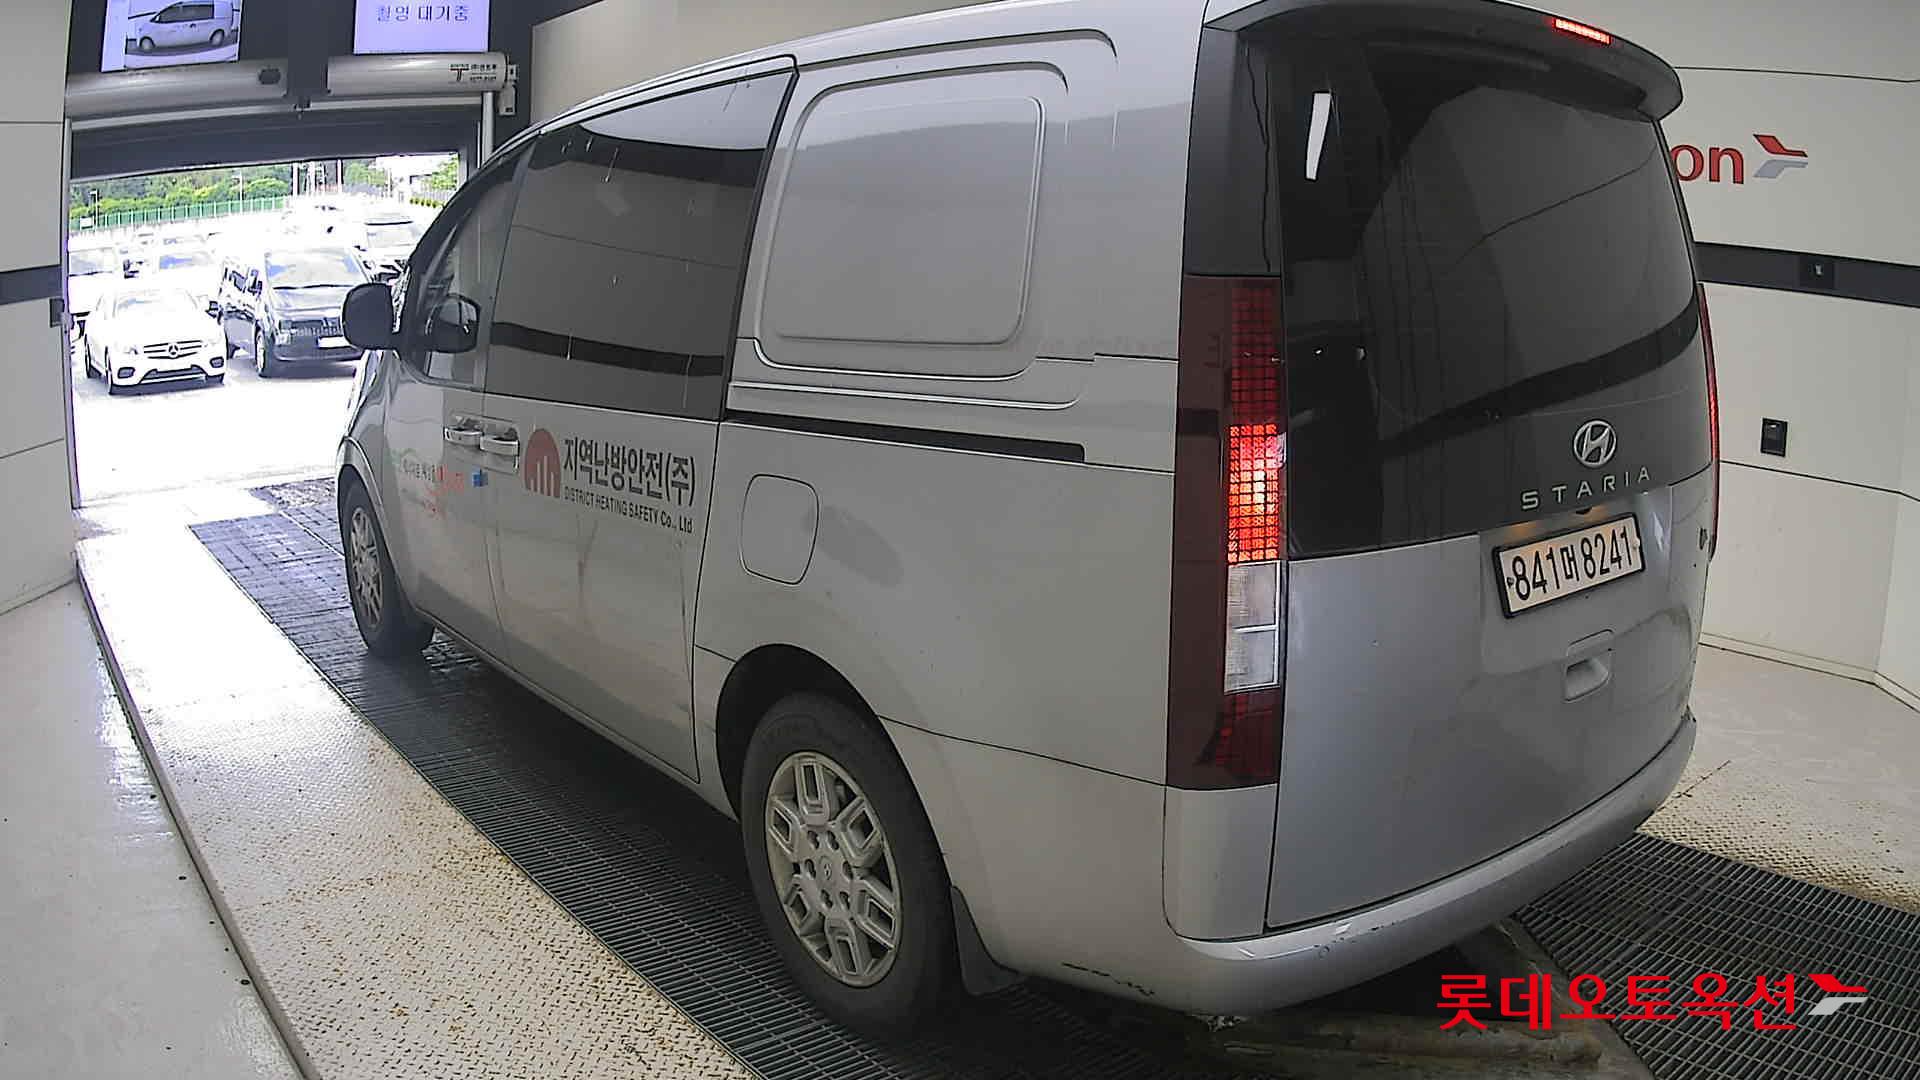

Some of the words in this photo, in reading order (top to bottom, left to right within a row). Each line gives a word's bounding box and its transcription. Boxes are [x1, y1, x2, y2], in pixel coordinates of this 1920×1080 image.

[417, 5, 468, 22] 대기중
[563, 436, 696, 507] 지역난방안전(주)
[1521, 466, 1650, 510] STARIA
[564, 485, 595, 508] DISTRICT
[595, 493, 628, 517] HEATING
[628, 501, 659, 525] SAFETY
[1511, 525, 1632, 601] 841머8241
